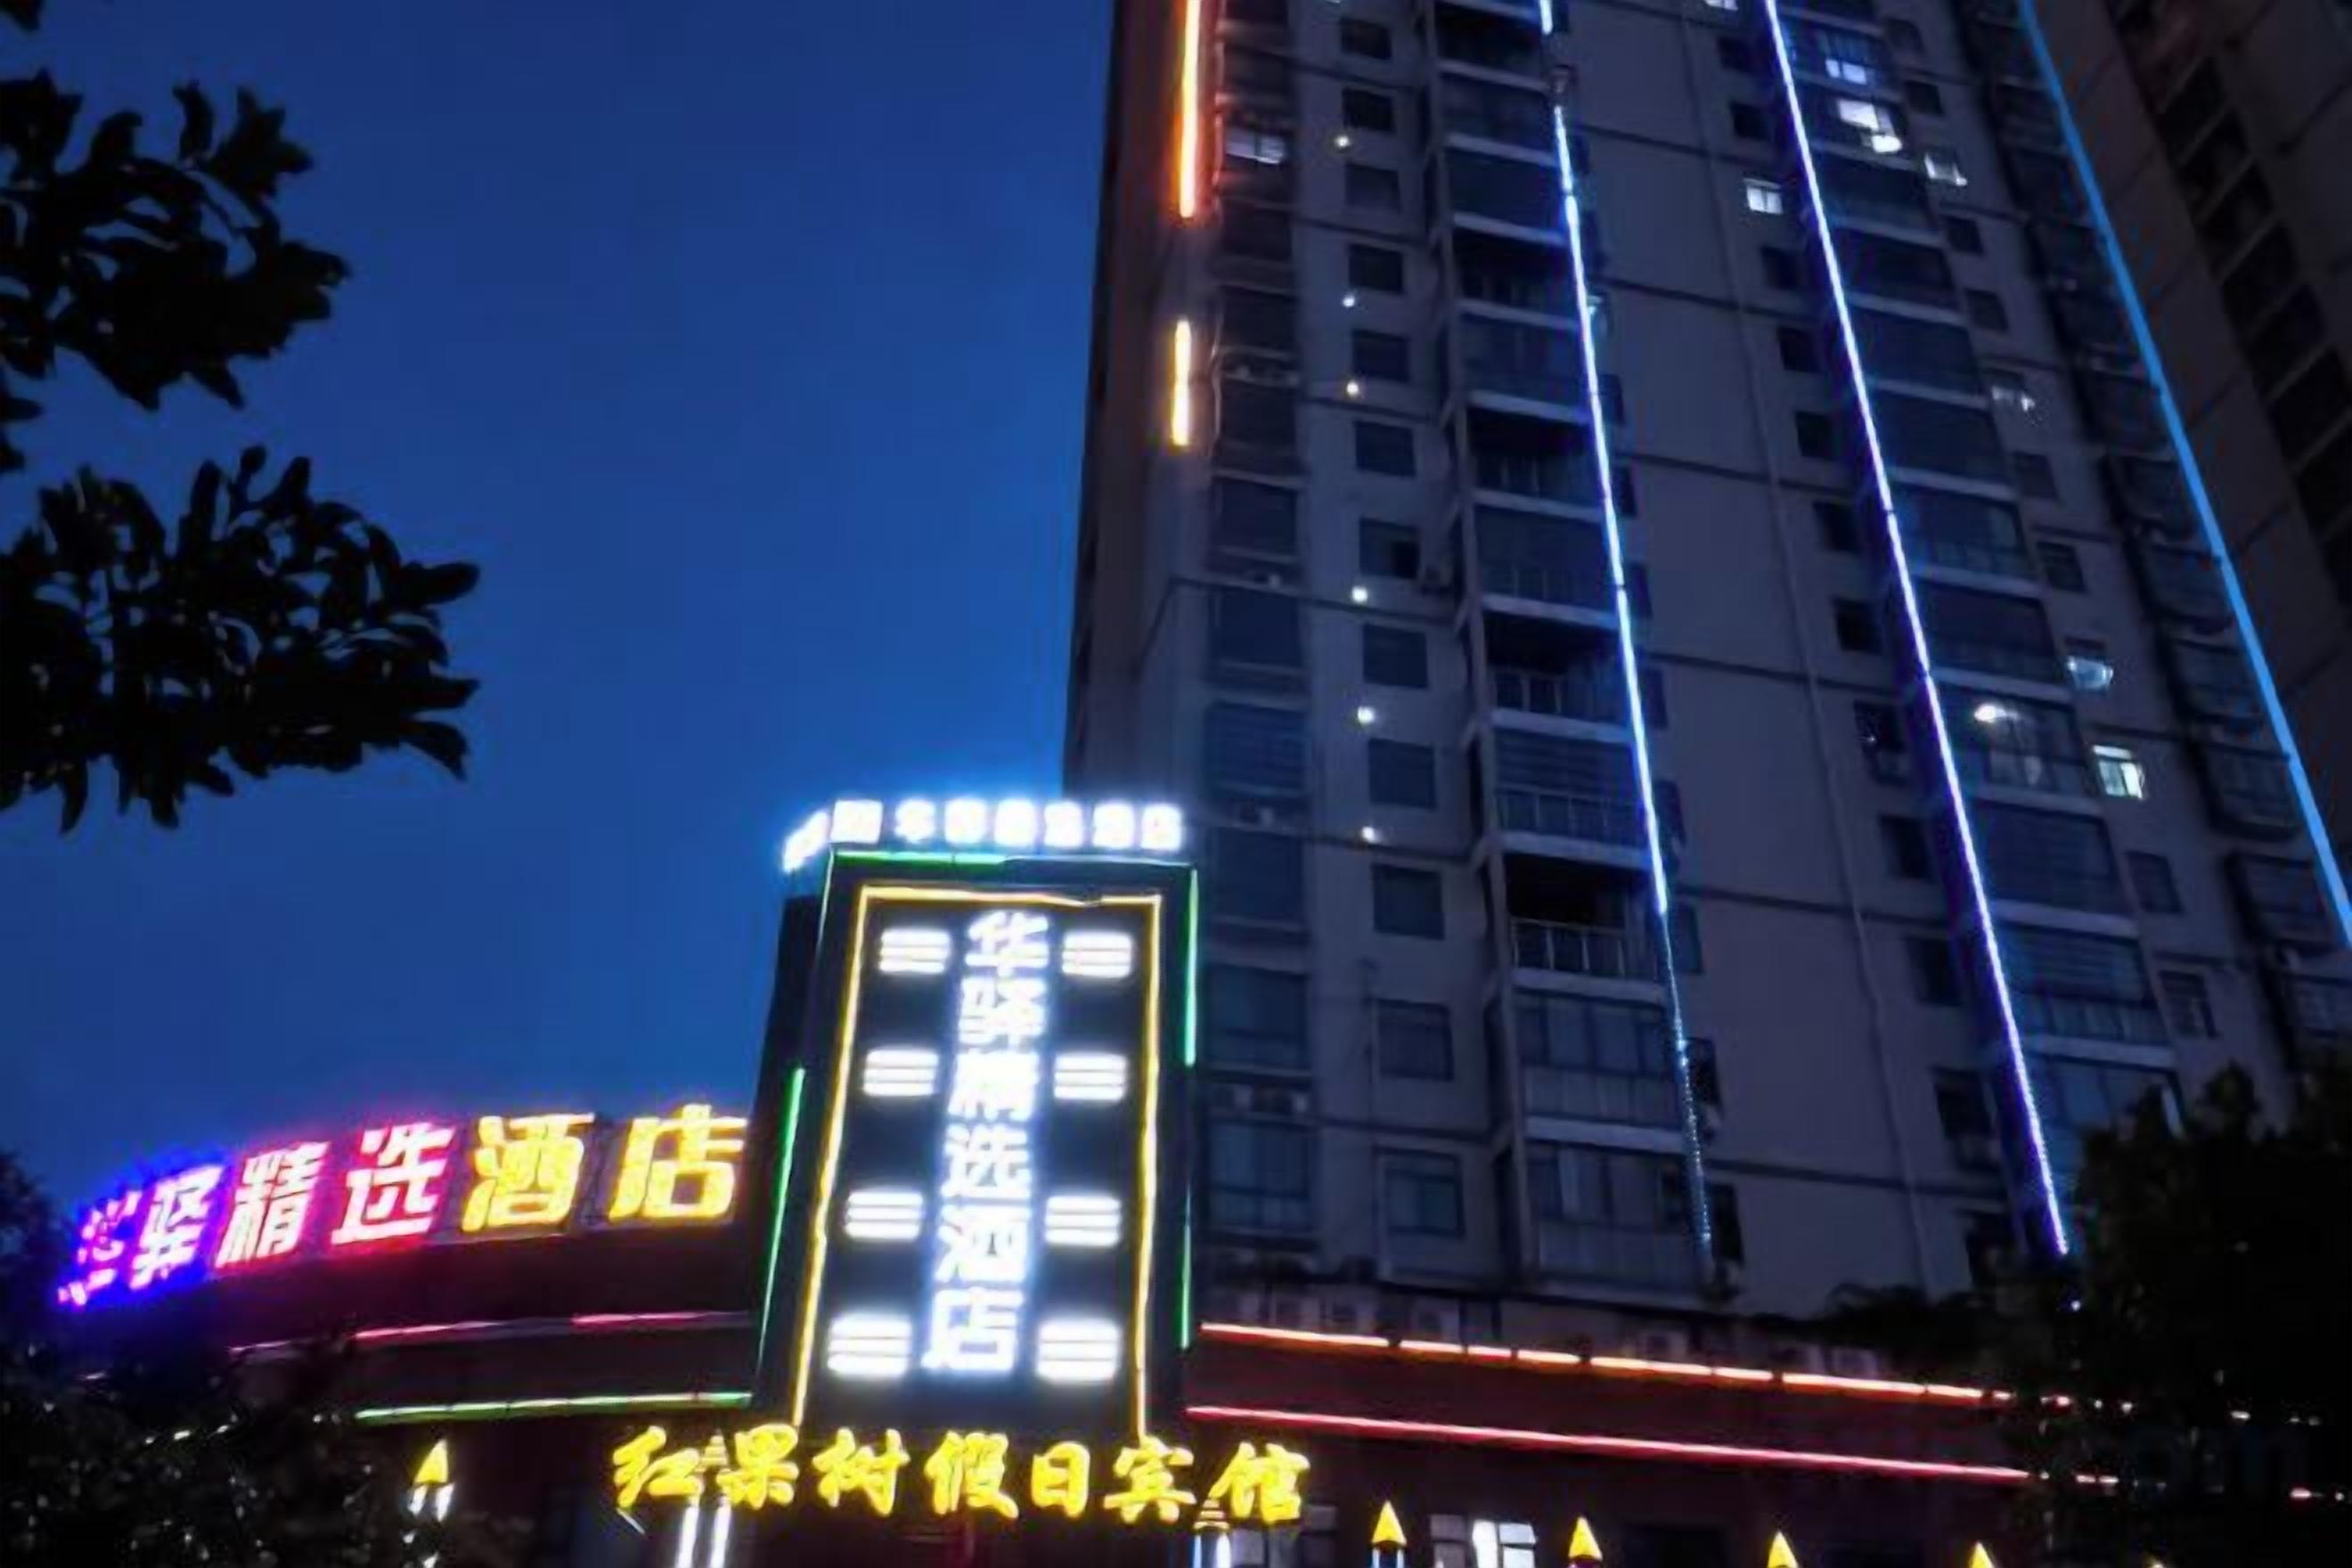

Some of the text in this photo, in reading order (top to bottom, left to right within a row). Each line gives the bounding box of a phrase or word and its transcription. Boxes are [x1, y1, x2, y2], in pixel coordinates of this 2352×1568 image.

[611, 1424, 1311, 1522] 红果树假日宾馆
